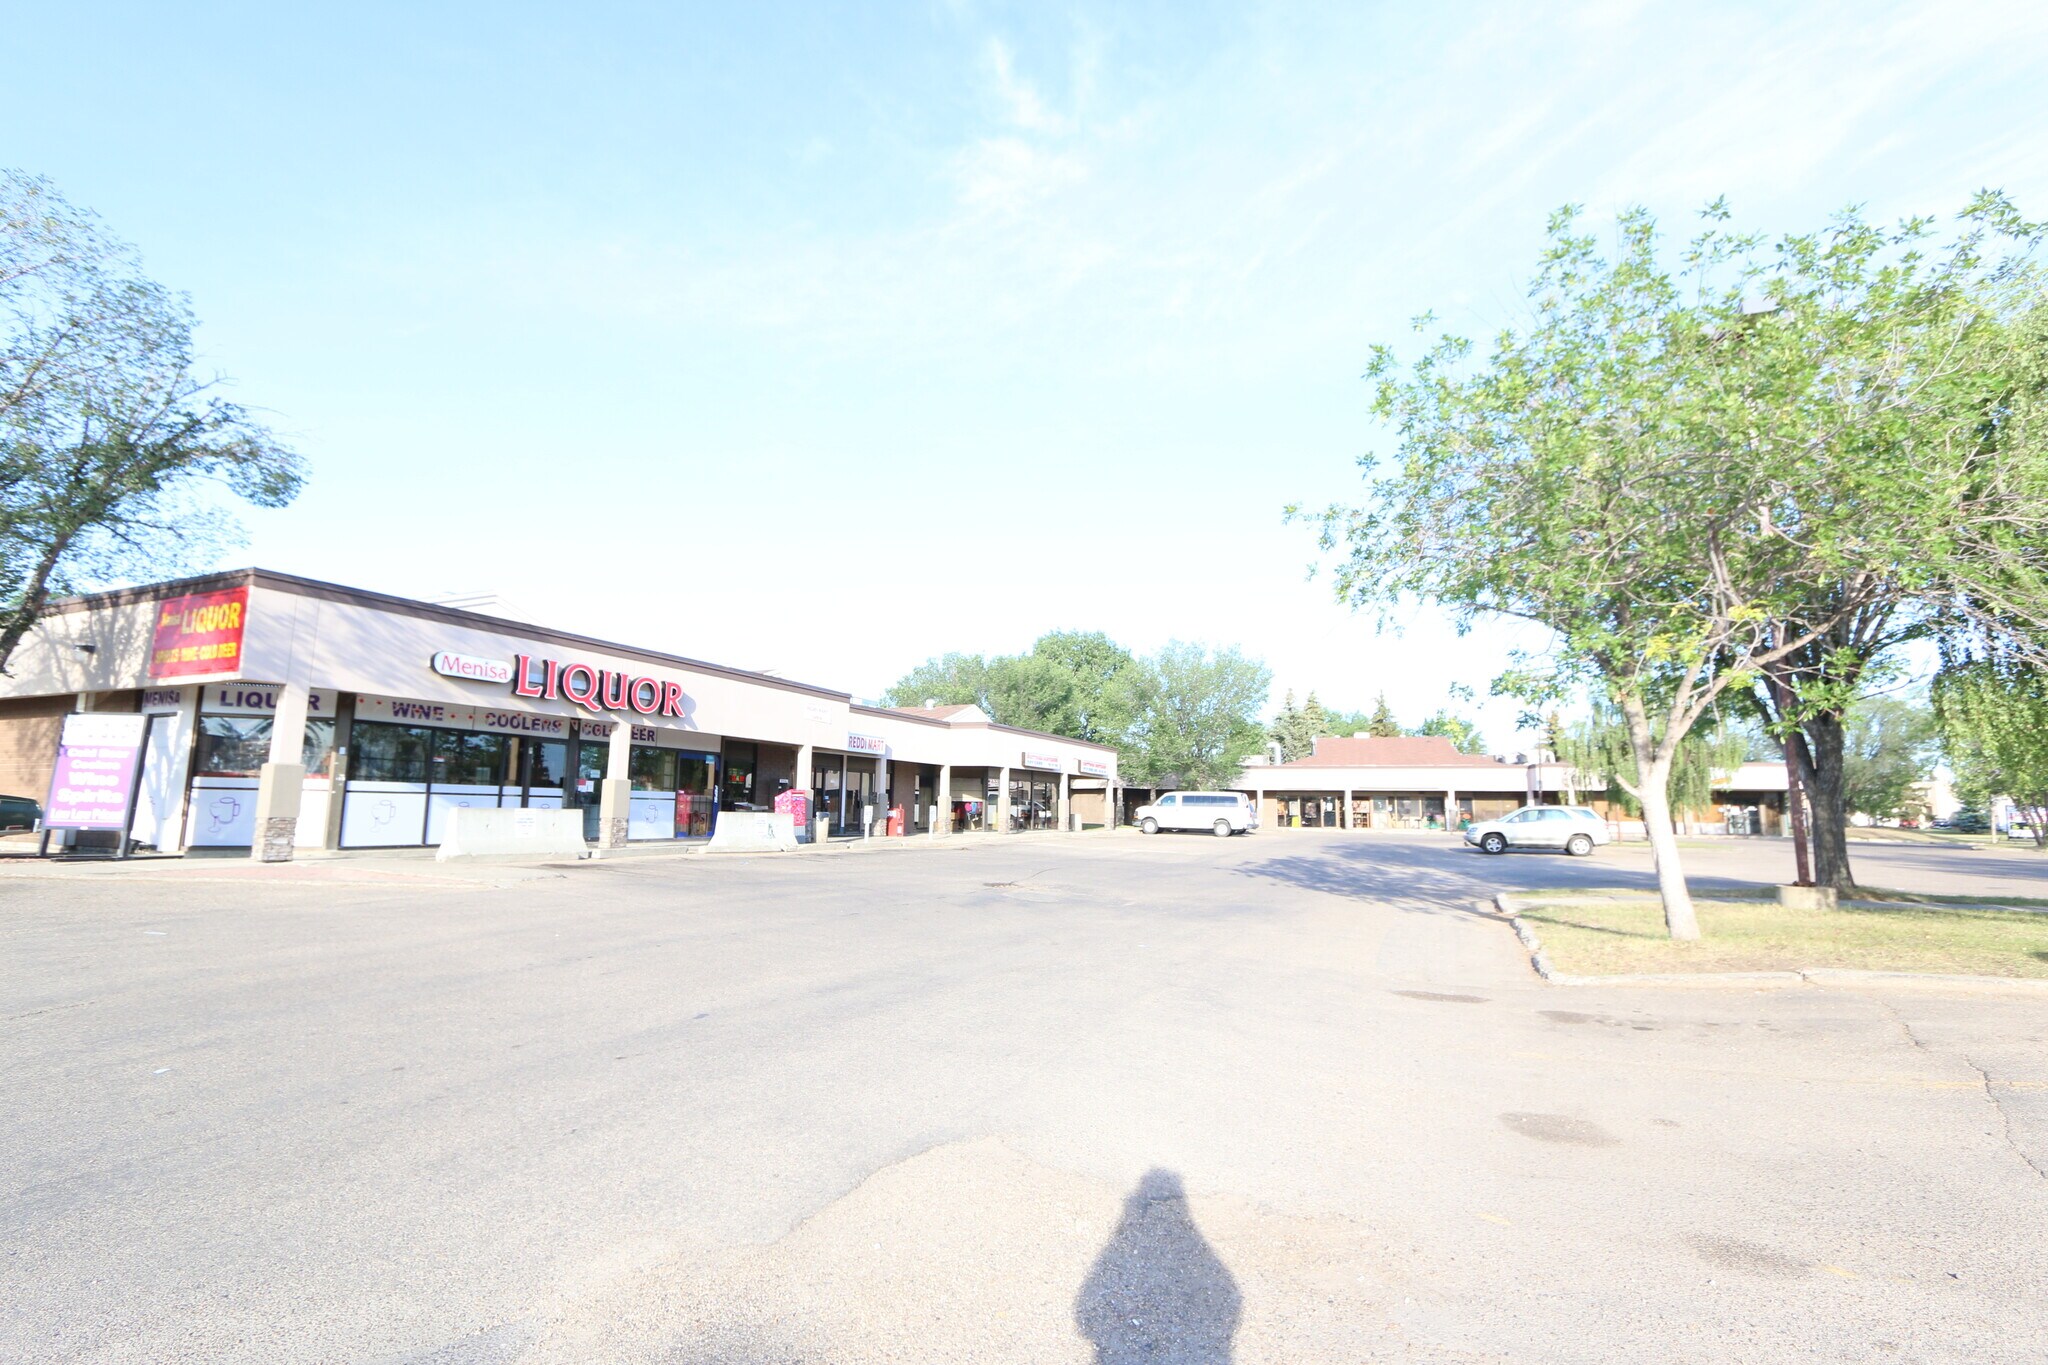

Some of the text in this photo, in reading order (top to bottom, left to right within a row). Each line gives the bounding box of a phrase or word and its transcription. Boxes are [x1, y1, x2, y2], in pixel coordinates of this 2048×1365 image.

[182, 602, 241, 634] LIQUOR
[439, 654, 684, 717] Menisa LIQUOR
[219, 690, 319, 711] LIQUR
[391, 702, 444, 721] WINE
[484, 713, 561, 734] COOLERS
[848, 736, 884, 752] REDDI MART
